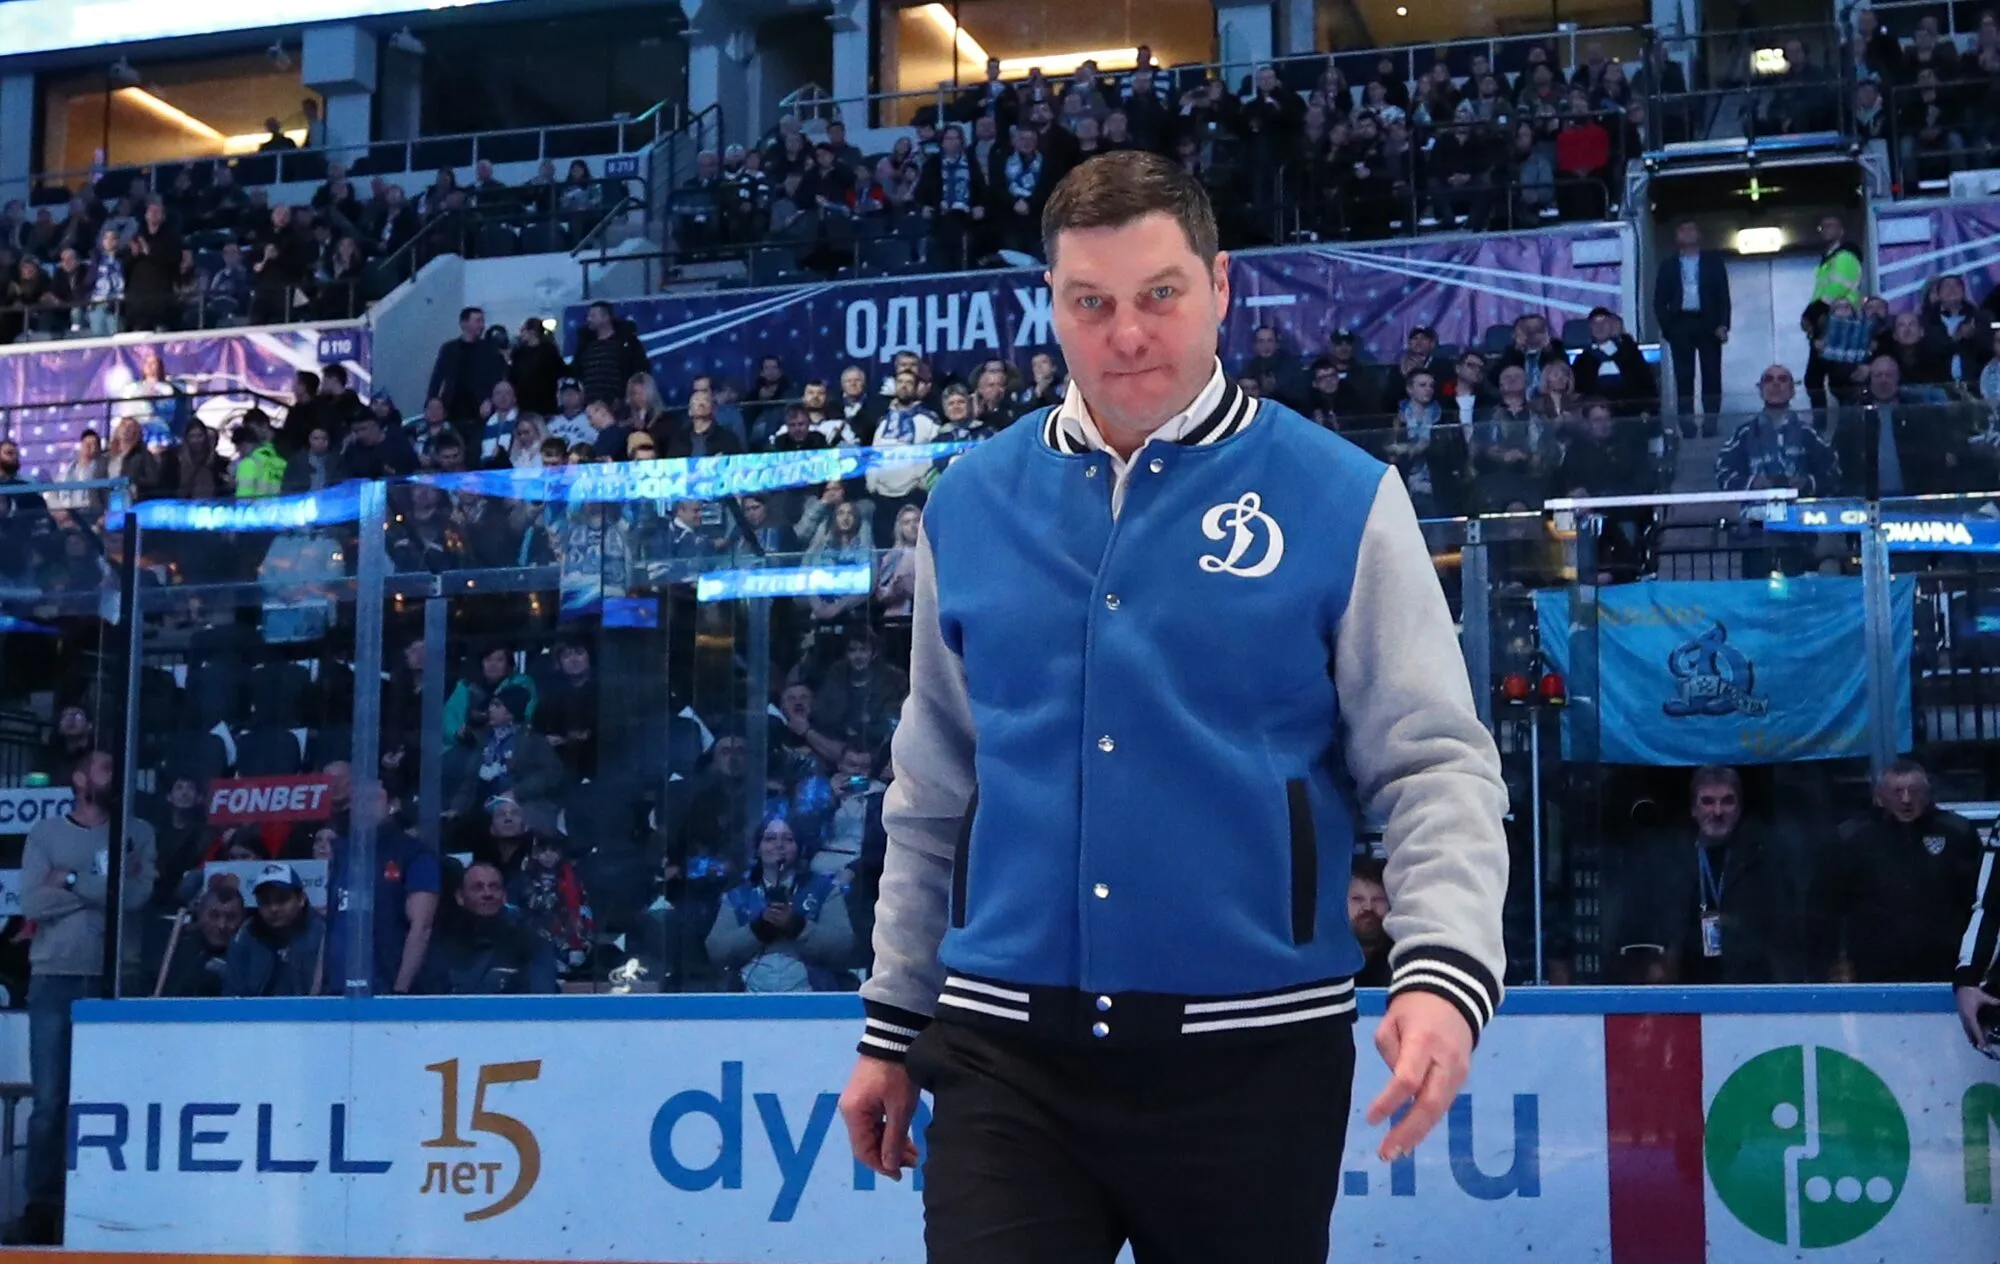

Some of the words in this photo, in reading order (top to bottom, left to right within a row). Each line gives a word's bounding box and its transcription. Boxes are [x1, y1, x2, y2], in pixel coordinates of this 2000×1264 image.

[846, 290, 1000, 363] ОДНА
[209, 783, 329, 814] FONBET
[66, 1103, 394, 1174] RIELL
[420, 1057, 543, 1222] 15
[420, 1161, 503, 1195] лет
